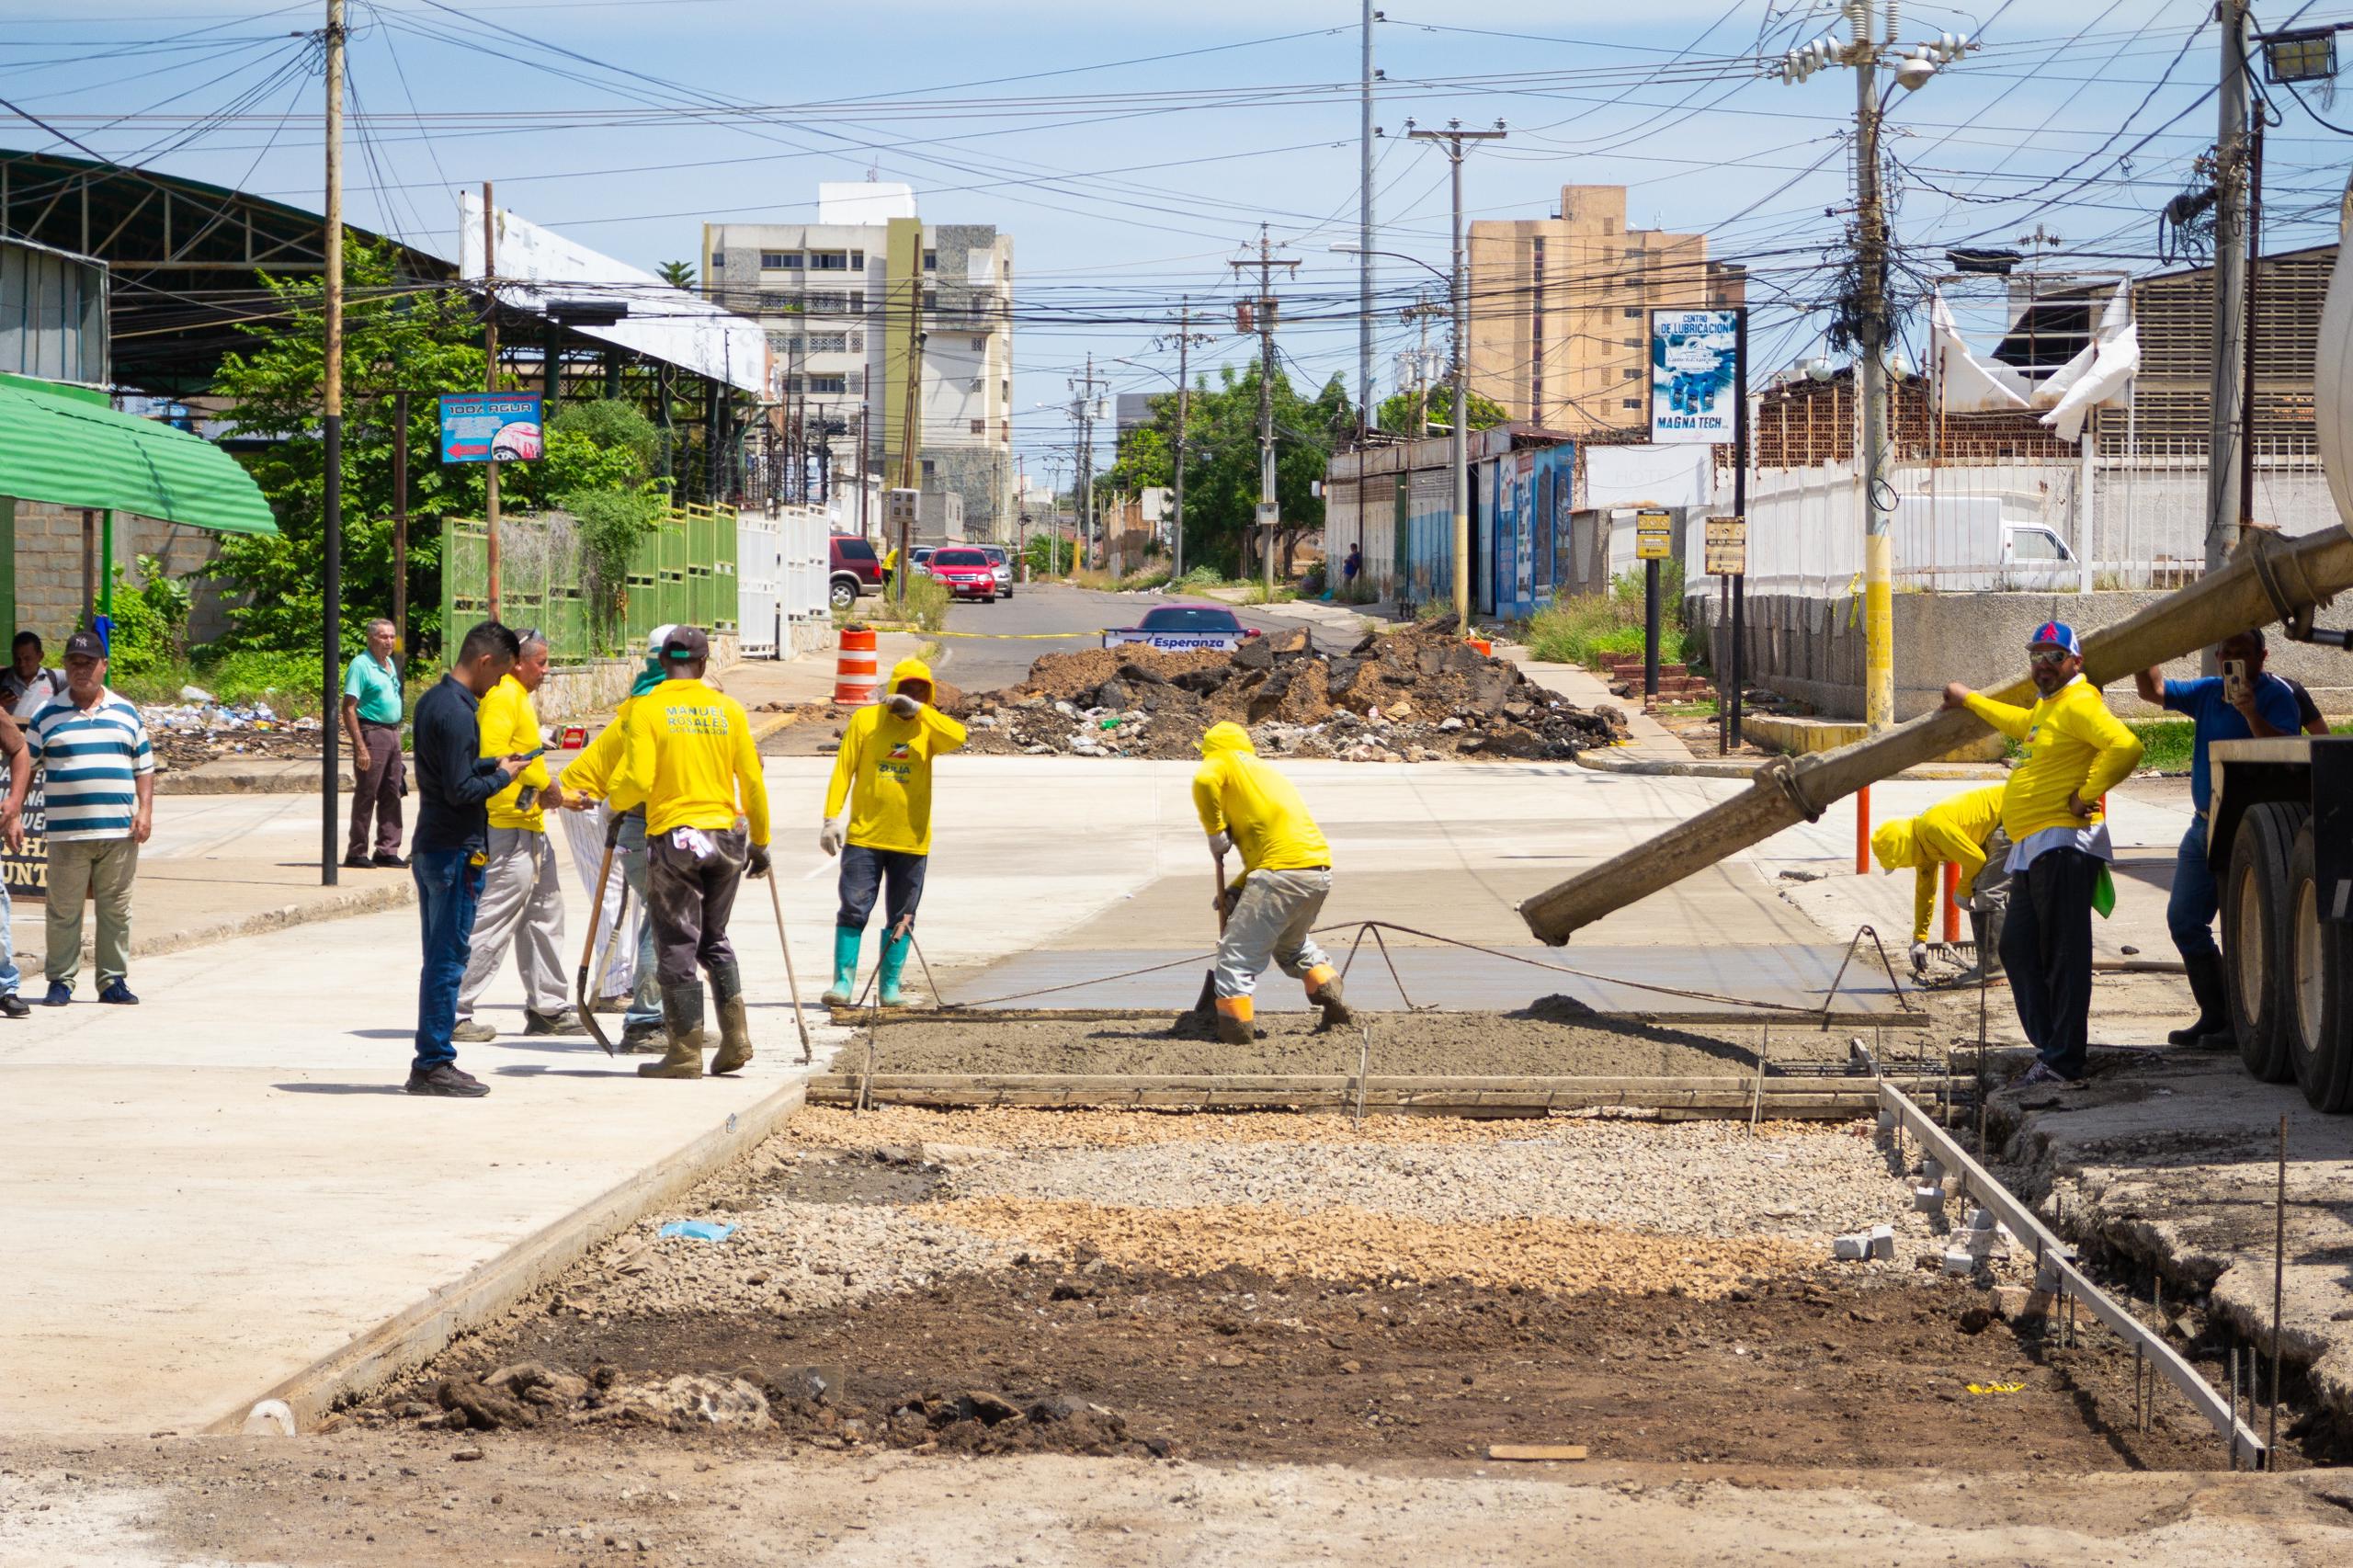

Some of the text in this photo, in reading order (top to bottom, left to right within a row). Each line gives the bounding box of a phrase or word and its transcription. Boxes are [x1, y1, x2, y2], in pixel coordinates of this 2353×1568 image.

[1683, 314, 1707, 323] CENTRO
[1661, 324, 1672, 334] DE
[450, 403, 532, 415] 100% AGUA
[1657, 416, 1722, 429] MAGNA TECH
[1154, 637, 1224, 649] Esperanza
[666, 707, 726, 718] MANUEL
[668, 717, 728, 728] ROSALES
